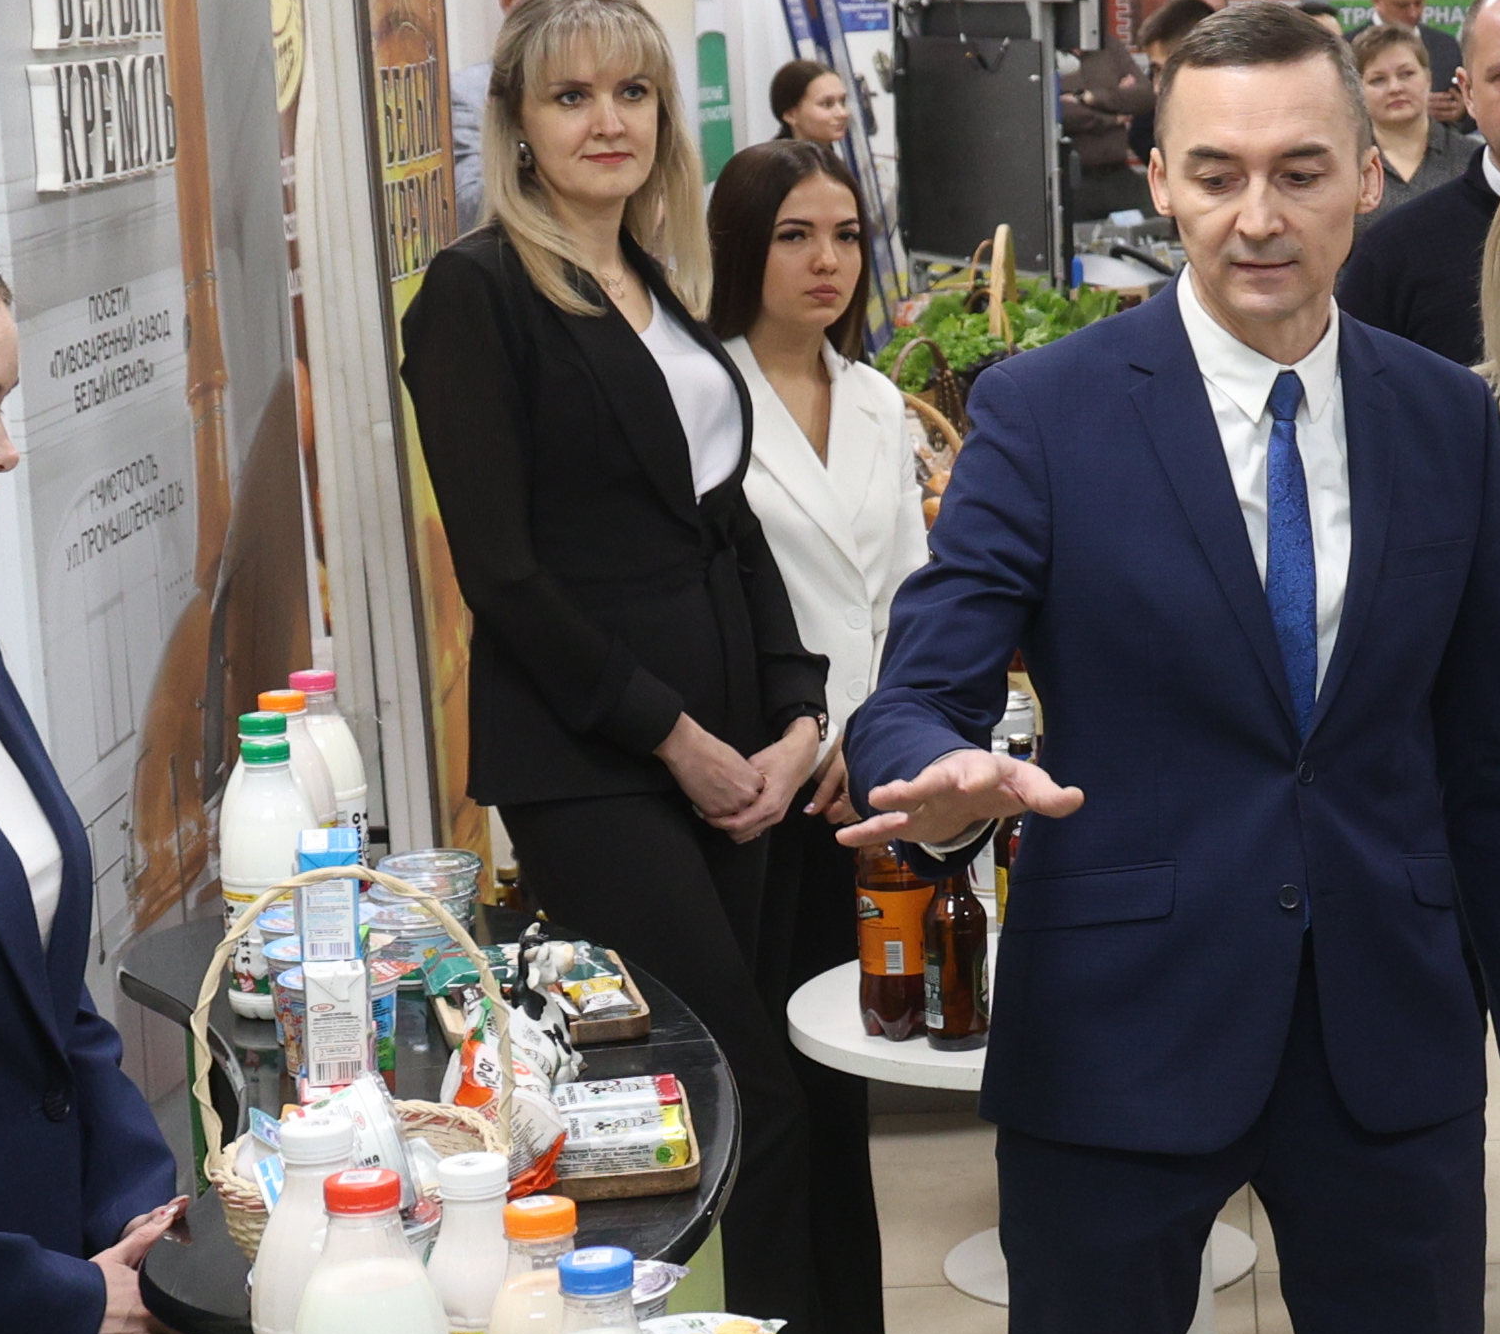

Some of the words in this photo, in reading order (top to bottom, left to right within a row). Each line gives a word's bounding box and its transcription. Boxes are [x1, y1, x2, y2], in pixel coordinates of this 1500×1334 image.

[46, 53, 178, 189] КРЕМЛЬ
[88, 285, 130, 325] ПОСЕТИ
[50, 317, 137, 378] «ПИВОВАРЕННЫЙ
[137, 310, 171, 349] ЗАВОД
[74, 367, 111, 414] БЕЛЫЙ
[110, 356, 155, 401] КРЕМЛЬ»
